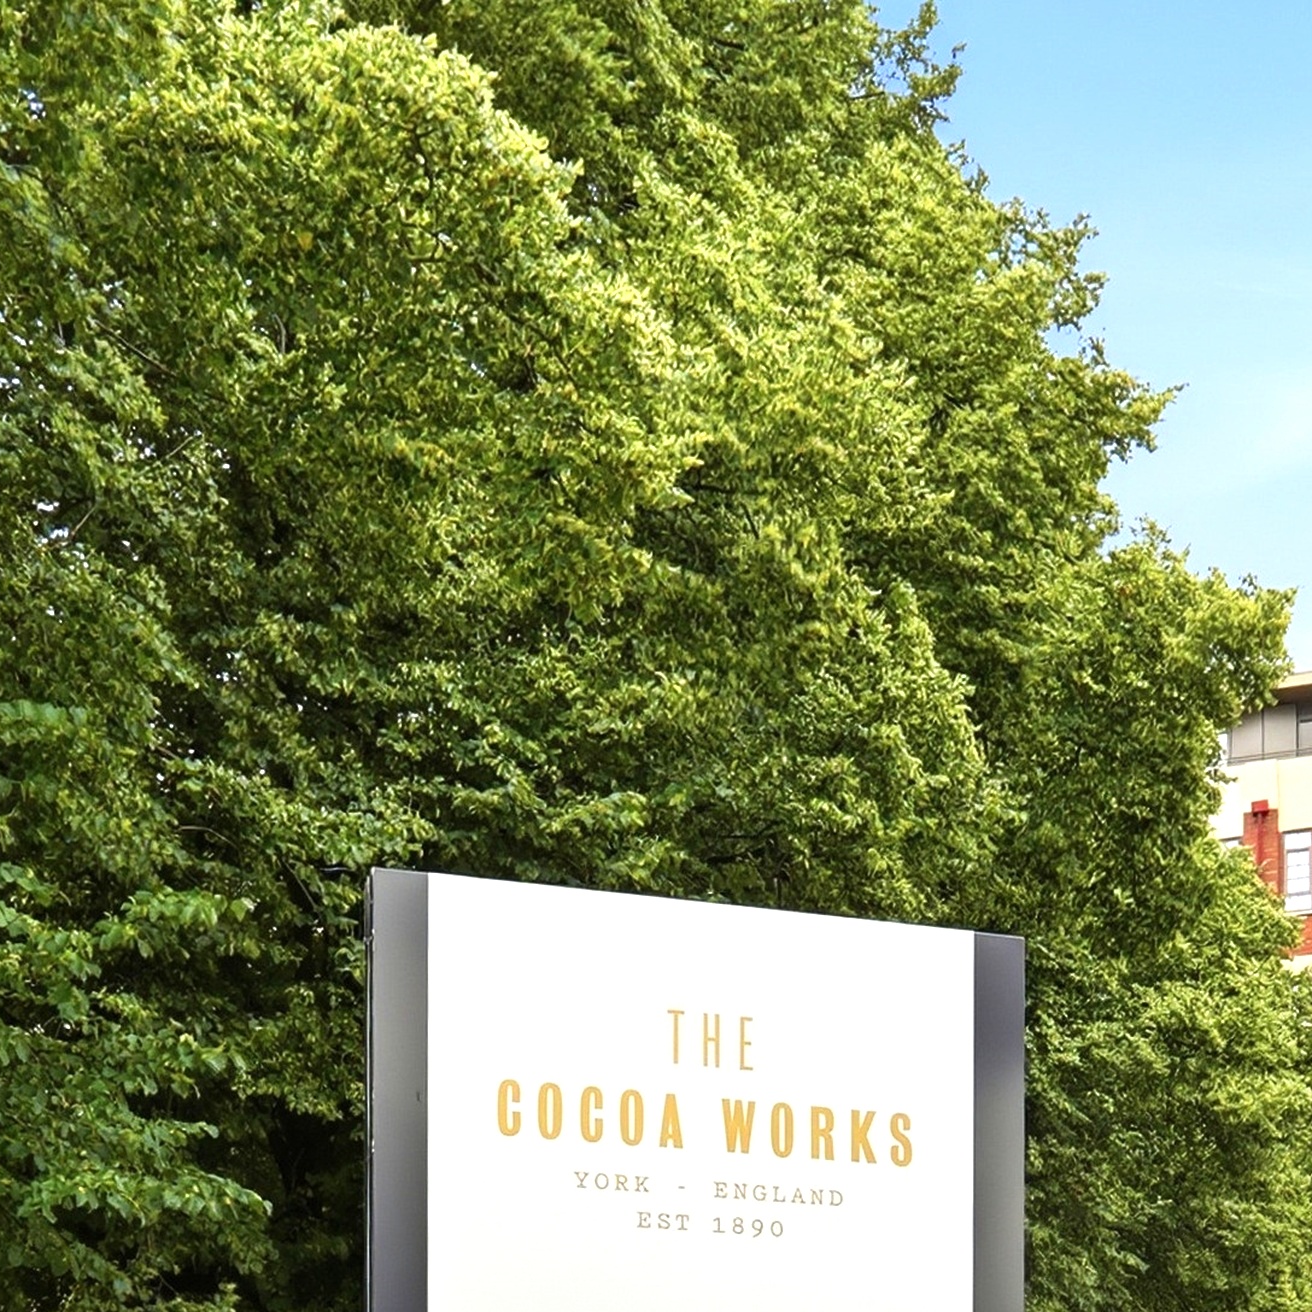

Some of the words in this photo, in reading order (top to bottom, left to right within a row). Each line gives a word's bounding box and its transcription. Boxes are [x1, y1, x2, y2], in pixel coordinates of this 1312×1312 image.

[667, 1009, 754, 1071] THE
[497, 1079, 684, 1149] COCOA
[721, 1098, 913, 1168] WORKS
[573, 1171, 651, 1194] YORK
[713, 1181, 845, 1207] ENGLAND
[636, 1211, 690, 1232] EST
[712, 1216, 785, 1238] 1890
